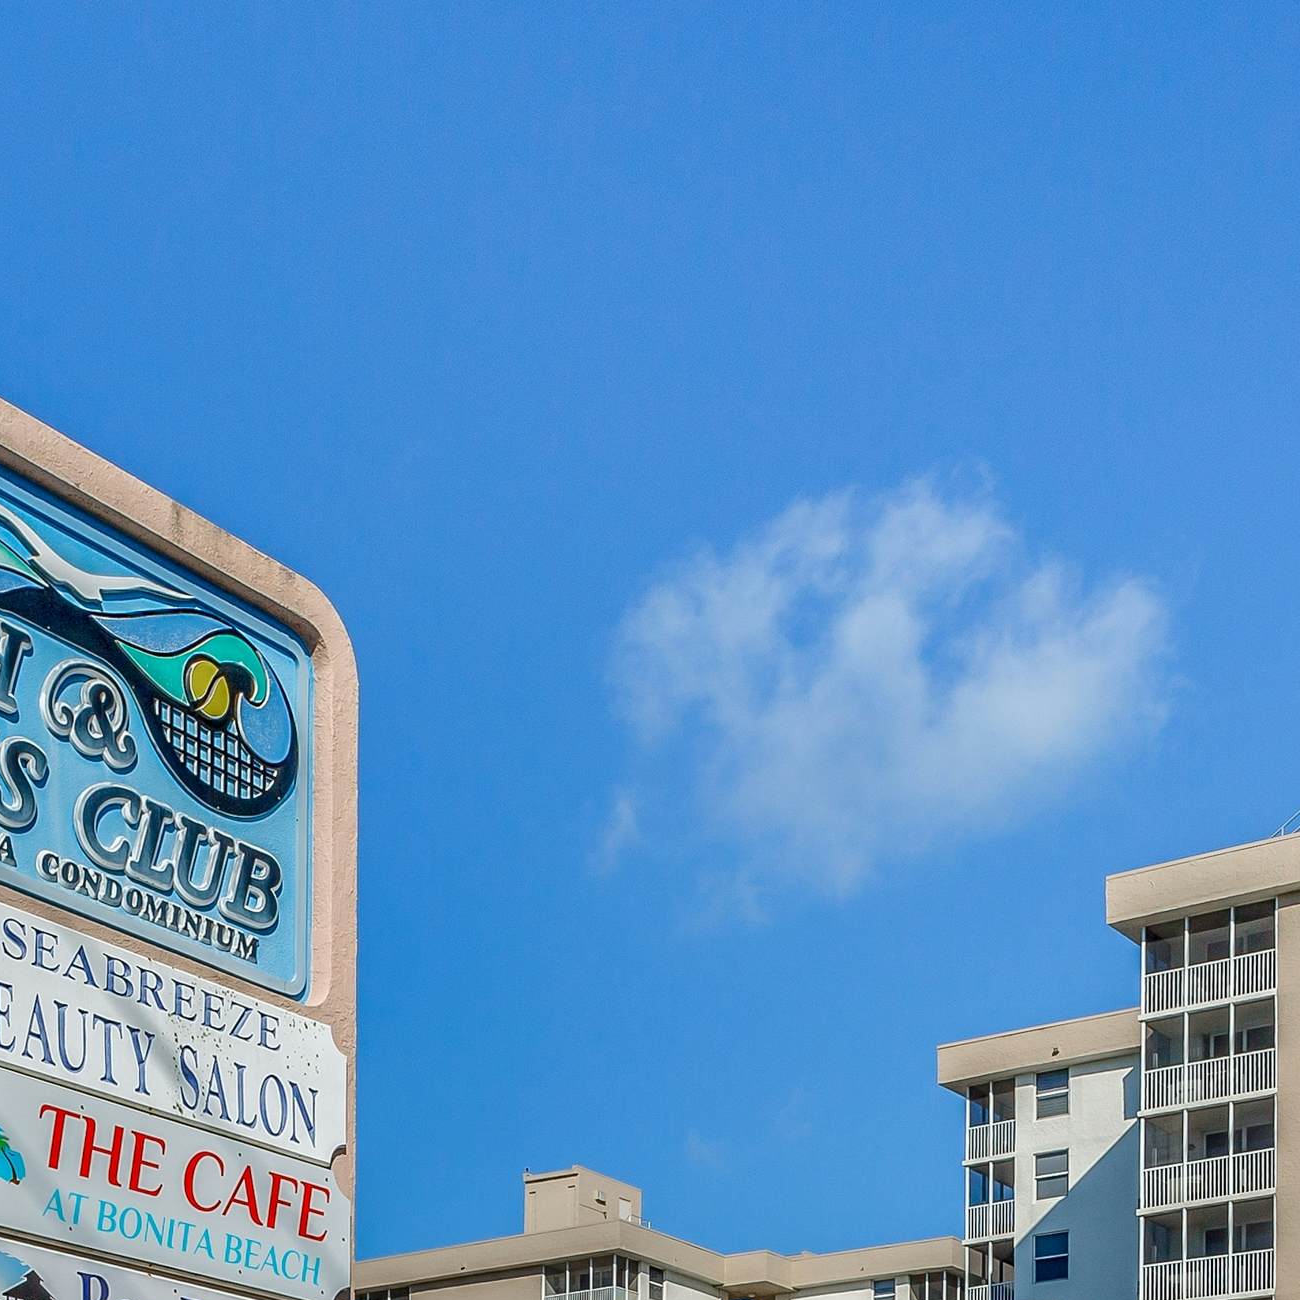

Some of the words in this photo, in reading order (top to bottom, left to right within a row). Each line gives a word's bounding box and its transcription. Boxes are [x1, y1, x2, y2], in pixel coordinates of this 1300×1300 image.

[39, 656, 138, 770] &
[37, 849, 260, 964] CONDOMINIUM
[73, 781, 283, 930] CLUB
[1, 918, 283, 1052] SEABREEZE
[179, 1045, 319, 1149] SALON
[39, 1103, 167, 1197] THE
[183, 1150, 331, 1243] CAFE
[42, 1188, 89, 1225] AT
[97, 1199, 216, 1260] BONITA
[223, 1232, 322, 1286] BEACH
